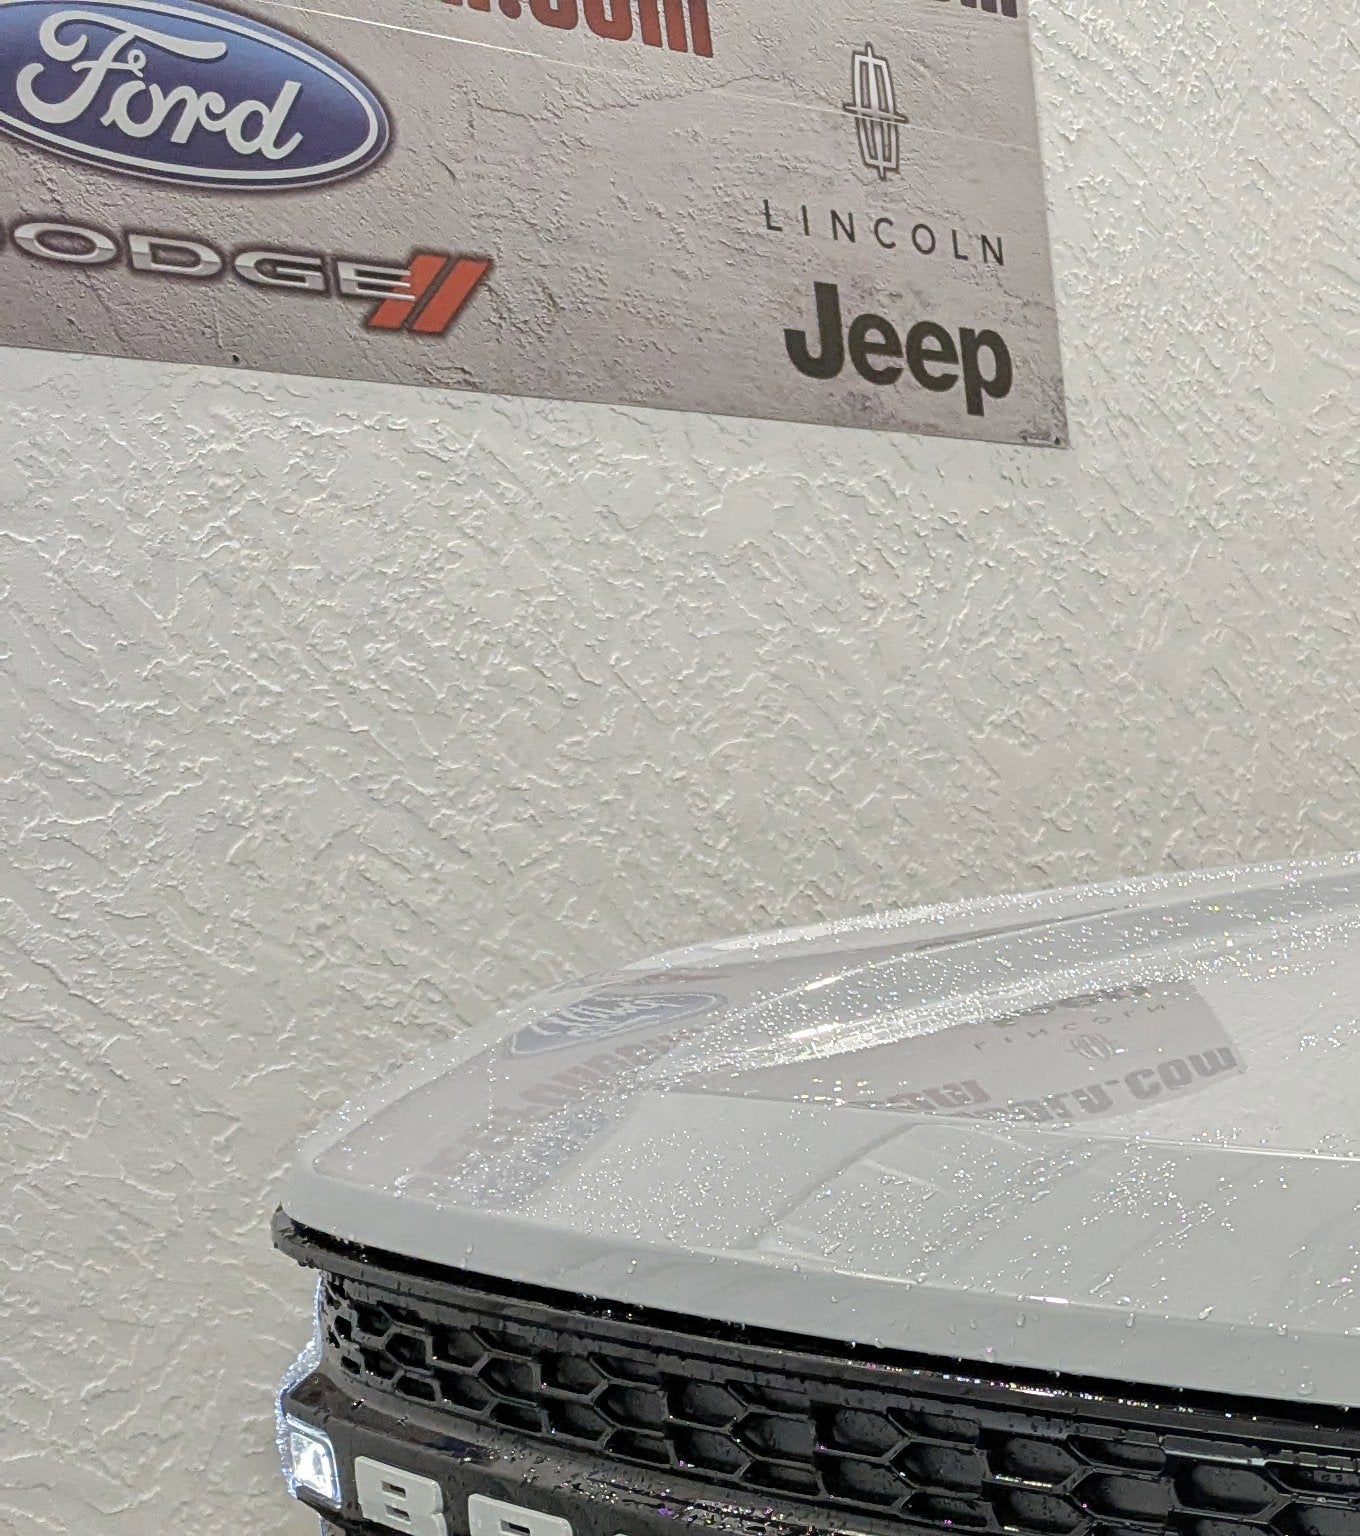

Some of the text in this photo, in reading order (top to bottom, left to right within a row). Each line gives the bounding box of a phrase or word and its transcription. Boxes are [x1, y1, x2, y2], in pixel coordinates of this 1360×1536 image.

[16, 10, 303, 160] Ford
[13, 222, 415, 300] ODGE
[764, 199, 1004, 266] LINCOLN
[783, 281, 1013, 416] Jeep
